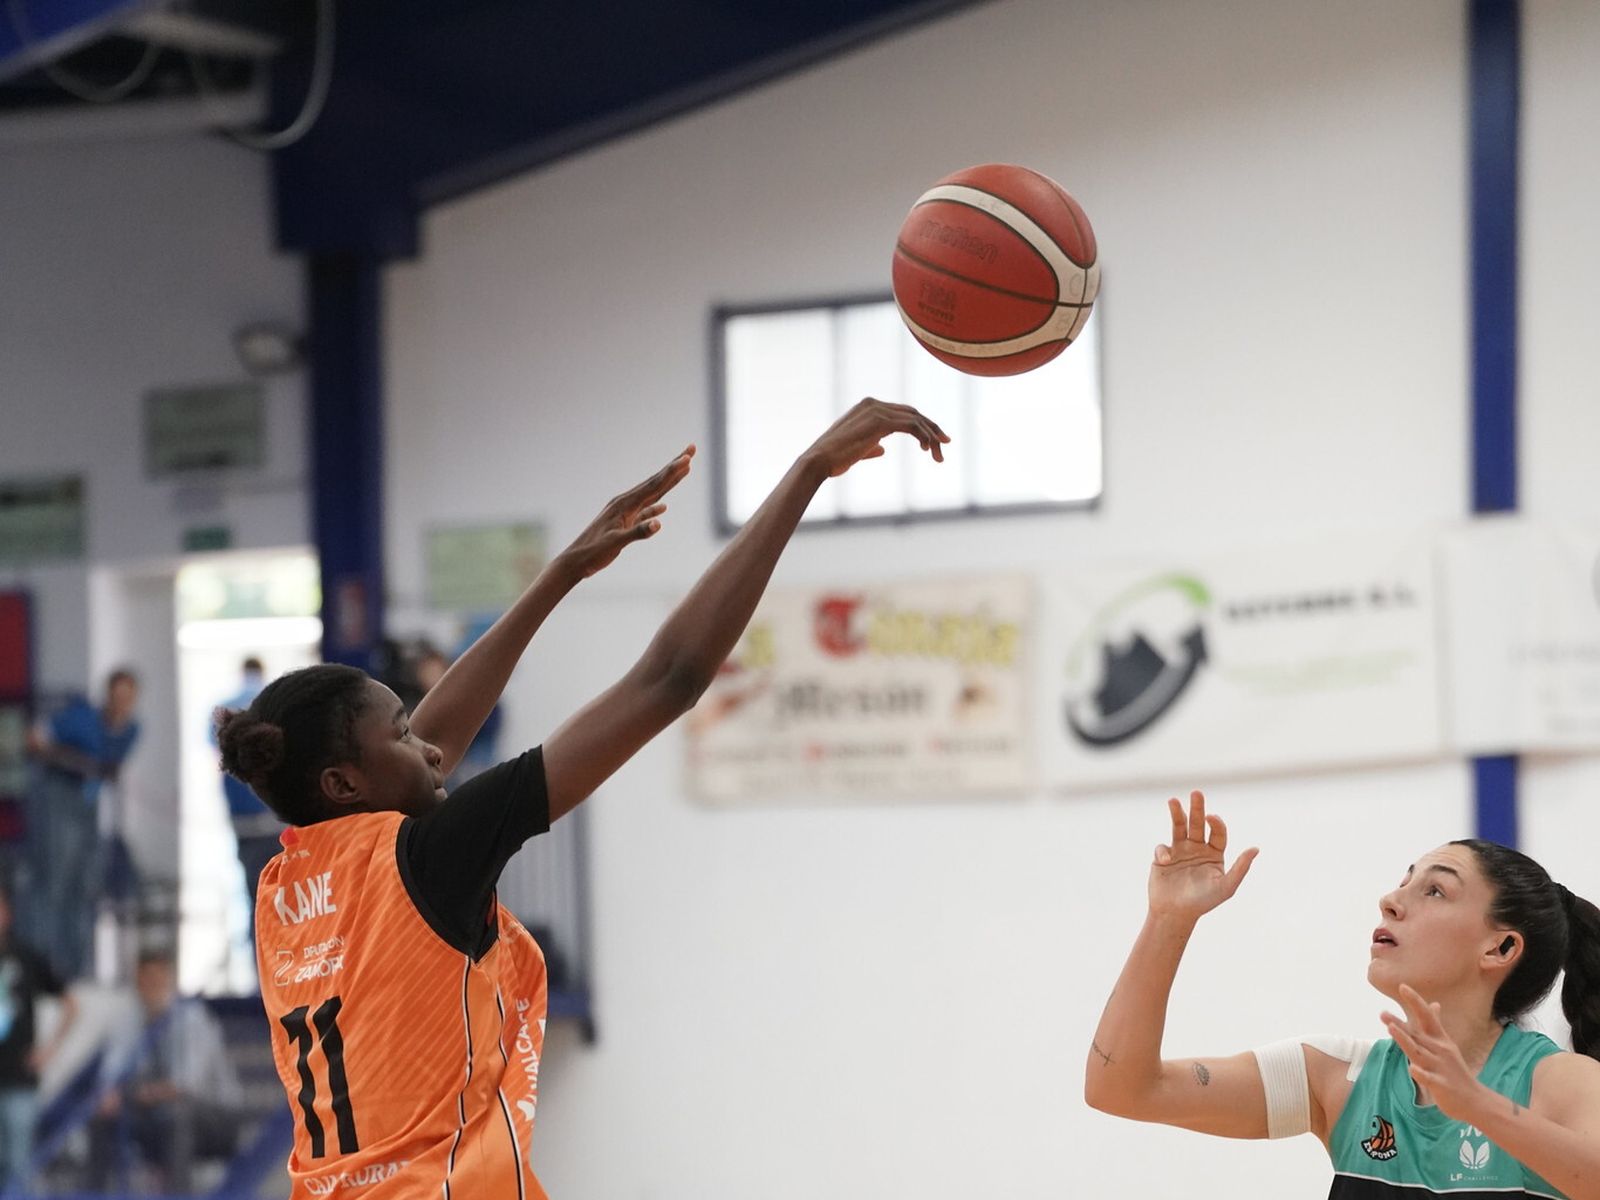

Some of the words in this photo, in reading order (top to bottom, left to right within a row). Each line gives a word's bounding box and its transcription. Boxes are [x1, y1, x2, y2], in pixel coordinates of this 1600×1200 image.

[919, 219, 999, 265] molten
[274, 871, 336, 926] KANE
[295, 954, 344, 983] ZAMORA
[280, 995, 360, 1159] 11
[1450, 1173, 1463, 1182] LF
